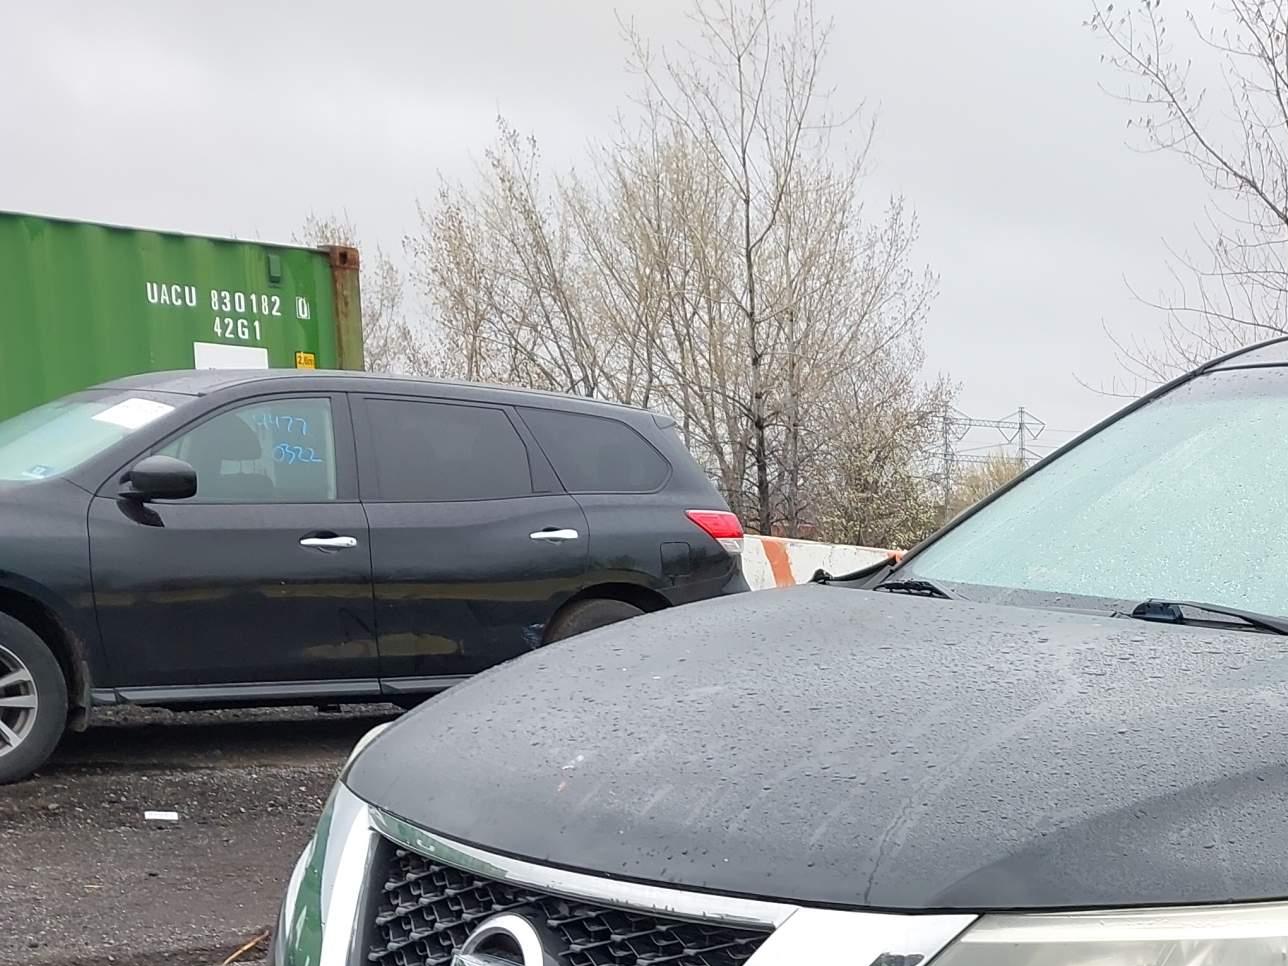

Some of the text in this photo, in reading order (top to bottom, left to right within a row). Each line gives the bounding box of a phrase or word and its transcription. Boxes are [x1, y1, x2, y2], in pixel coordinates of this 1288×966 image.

[146, 282, 197, 306] UACU
[210, 290, 282, 316] 830182
[213, 317, 261, 340] 42G1
